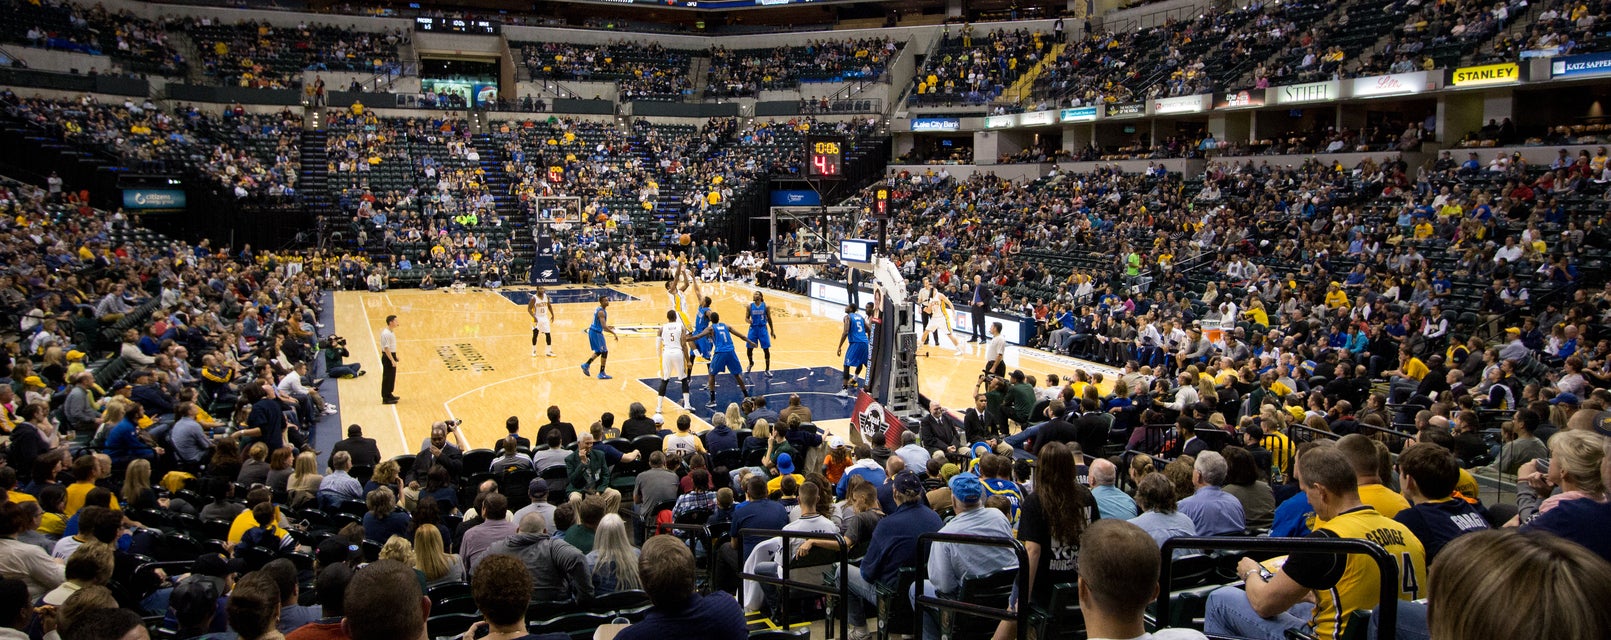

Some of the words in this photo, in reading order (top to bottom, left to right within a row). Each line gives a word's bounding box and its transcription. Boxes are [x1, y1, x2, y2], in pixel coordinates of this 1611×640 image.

[1566, 63, 1585, 71] KATZ
[1457, 67, 1514, 82] STANLEY
[1285, 84, 1328, 101] STIFEL
[931, 121, 943, 129] City
[815, 142, 839, 154] 10:06
[856, 321, 863, 333] 5
[670, 332, 675, 342] 5
[719, 331, 728, 343] 7
[1365, 528, 1406, 547] GEORGE
